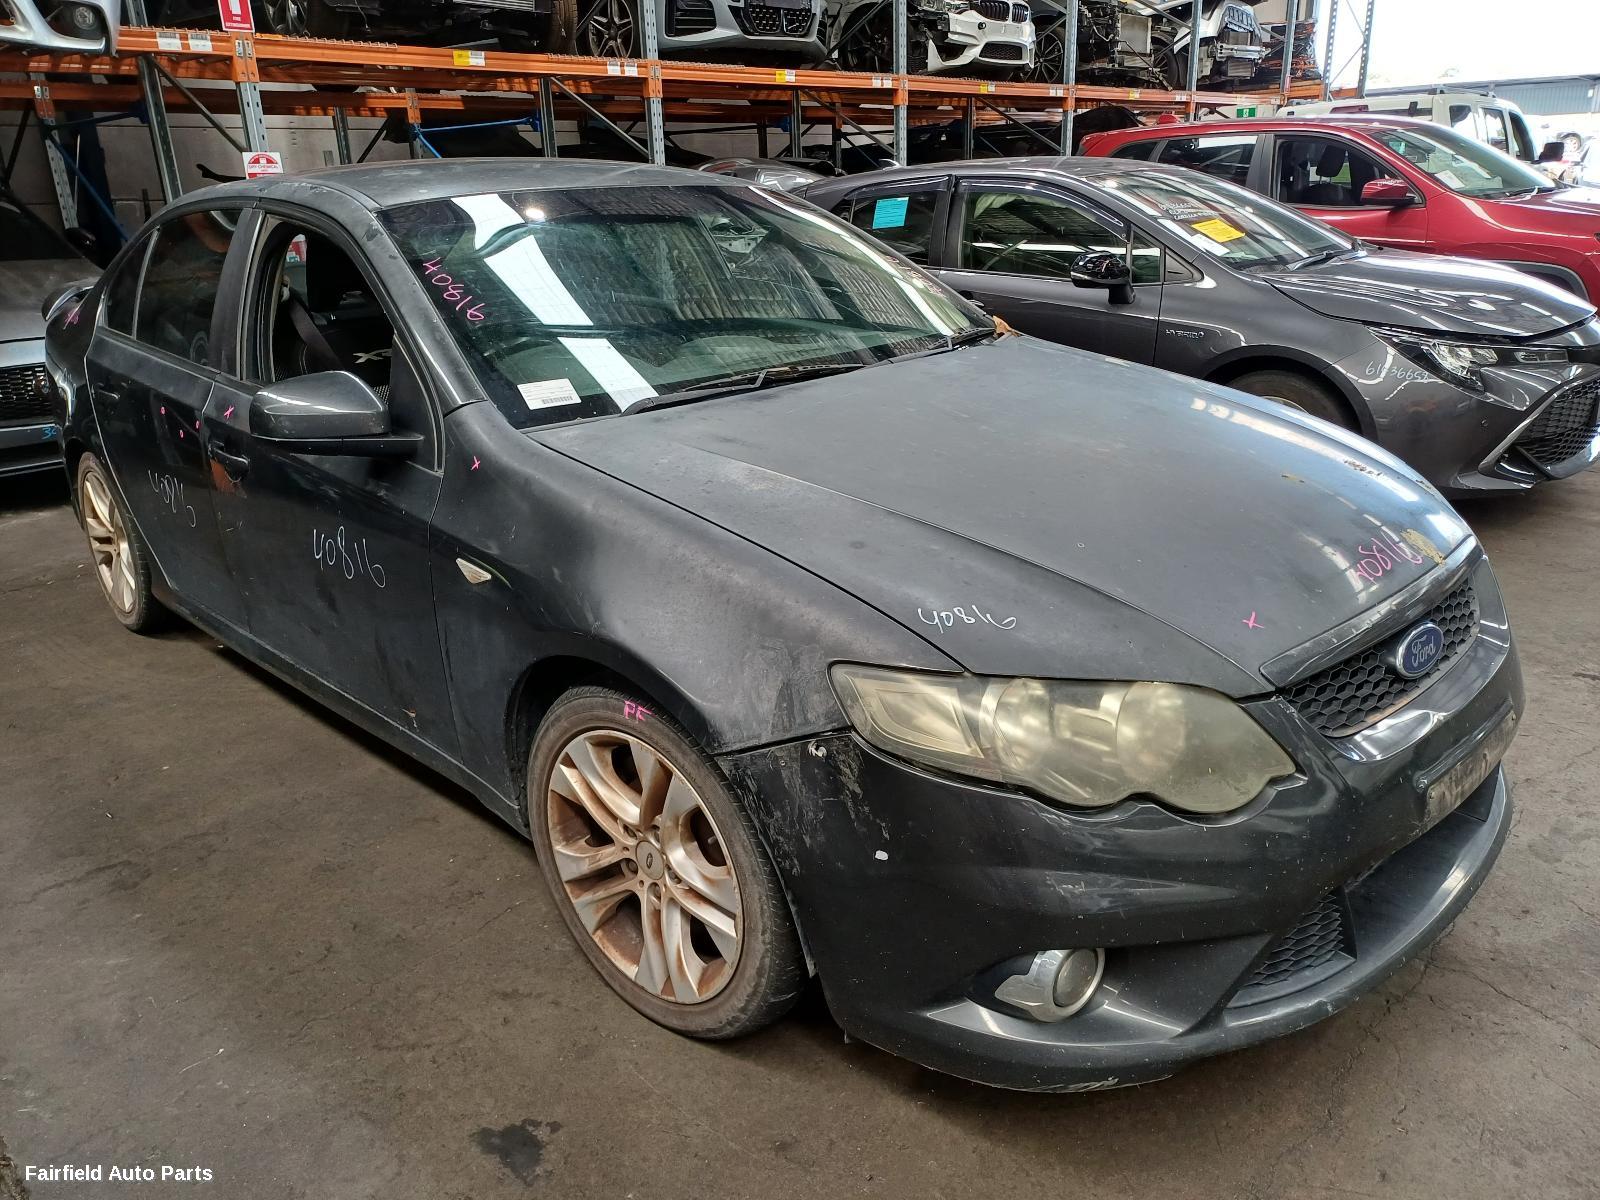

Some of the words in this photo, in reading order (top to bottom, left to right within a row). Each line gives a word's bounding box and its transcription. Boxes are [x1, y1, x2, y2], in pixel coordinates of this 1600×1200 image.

[422, 256, 485, 321] 40816
[312, 525, 387, 589] 40816
[917, 604, 1018, 634] 40816
[1411, 634, 1437, 668] Ford
